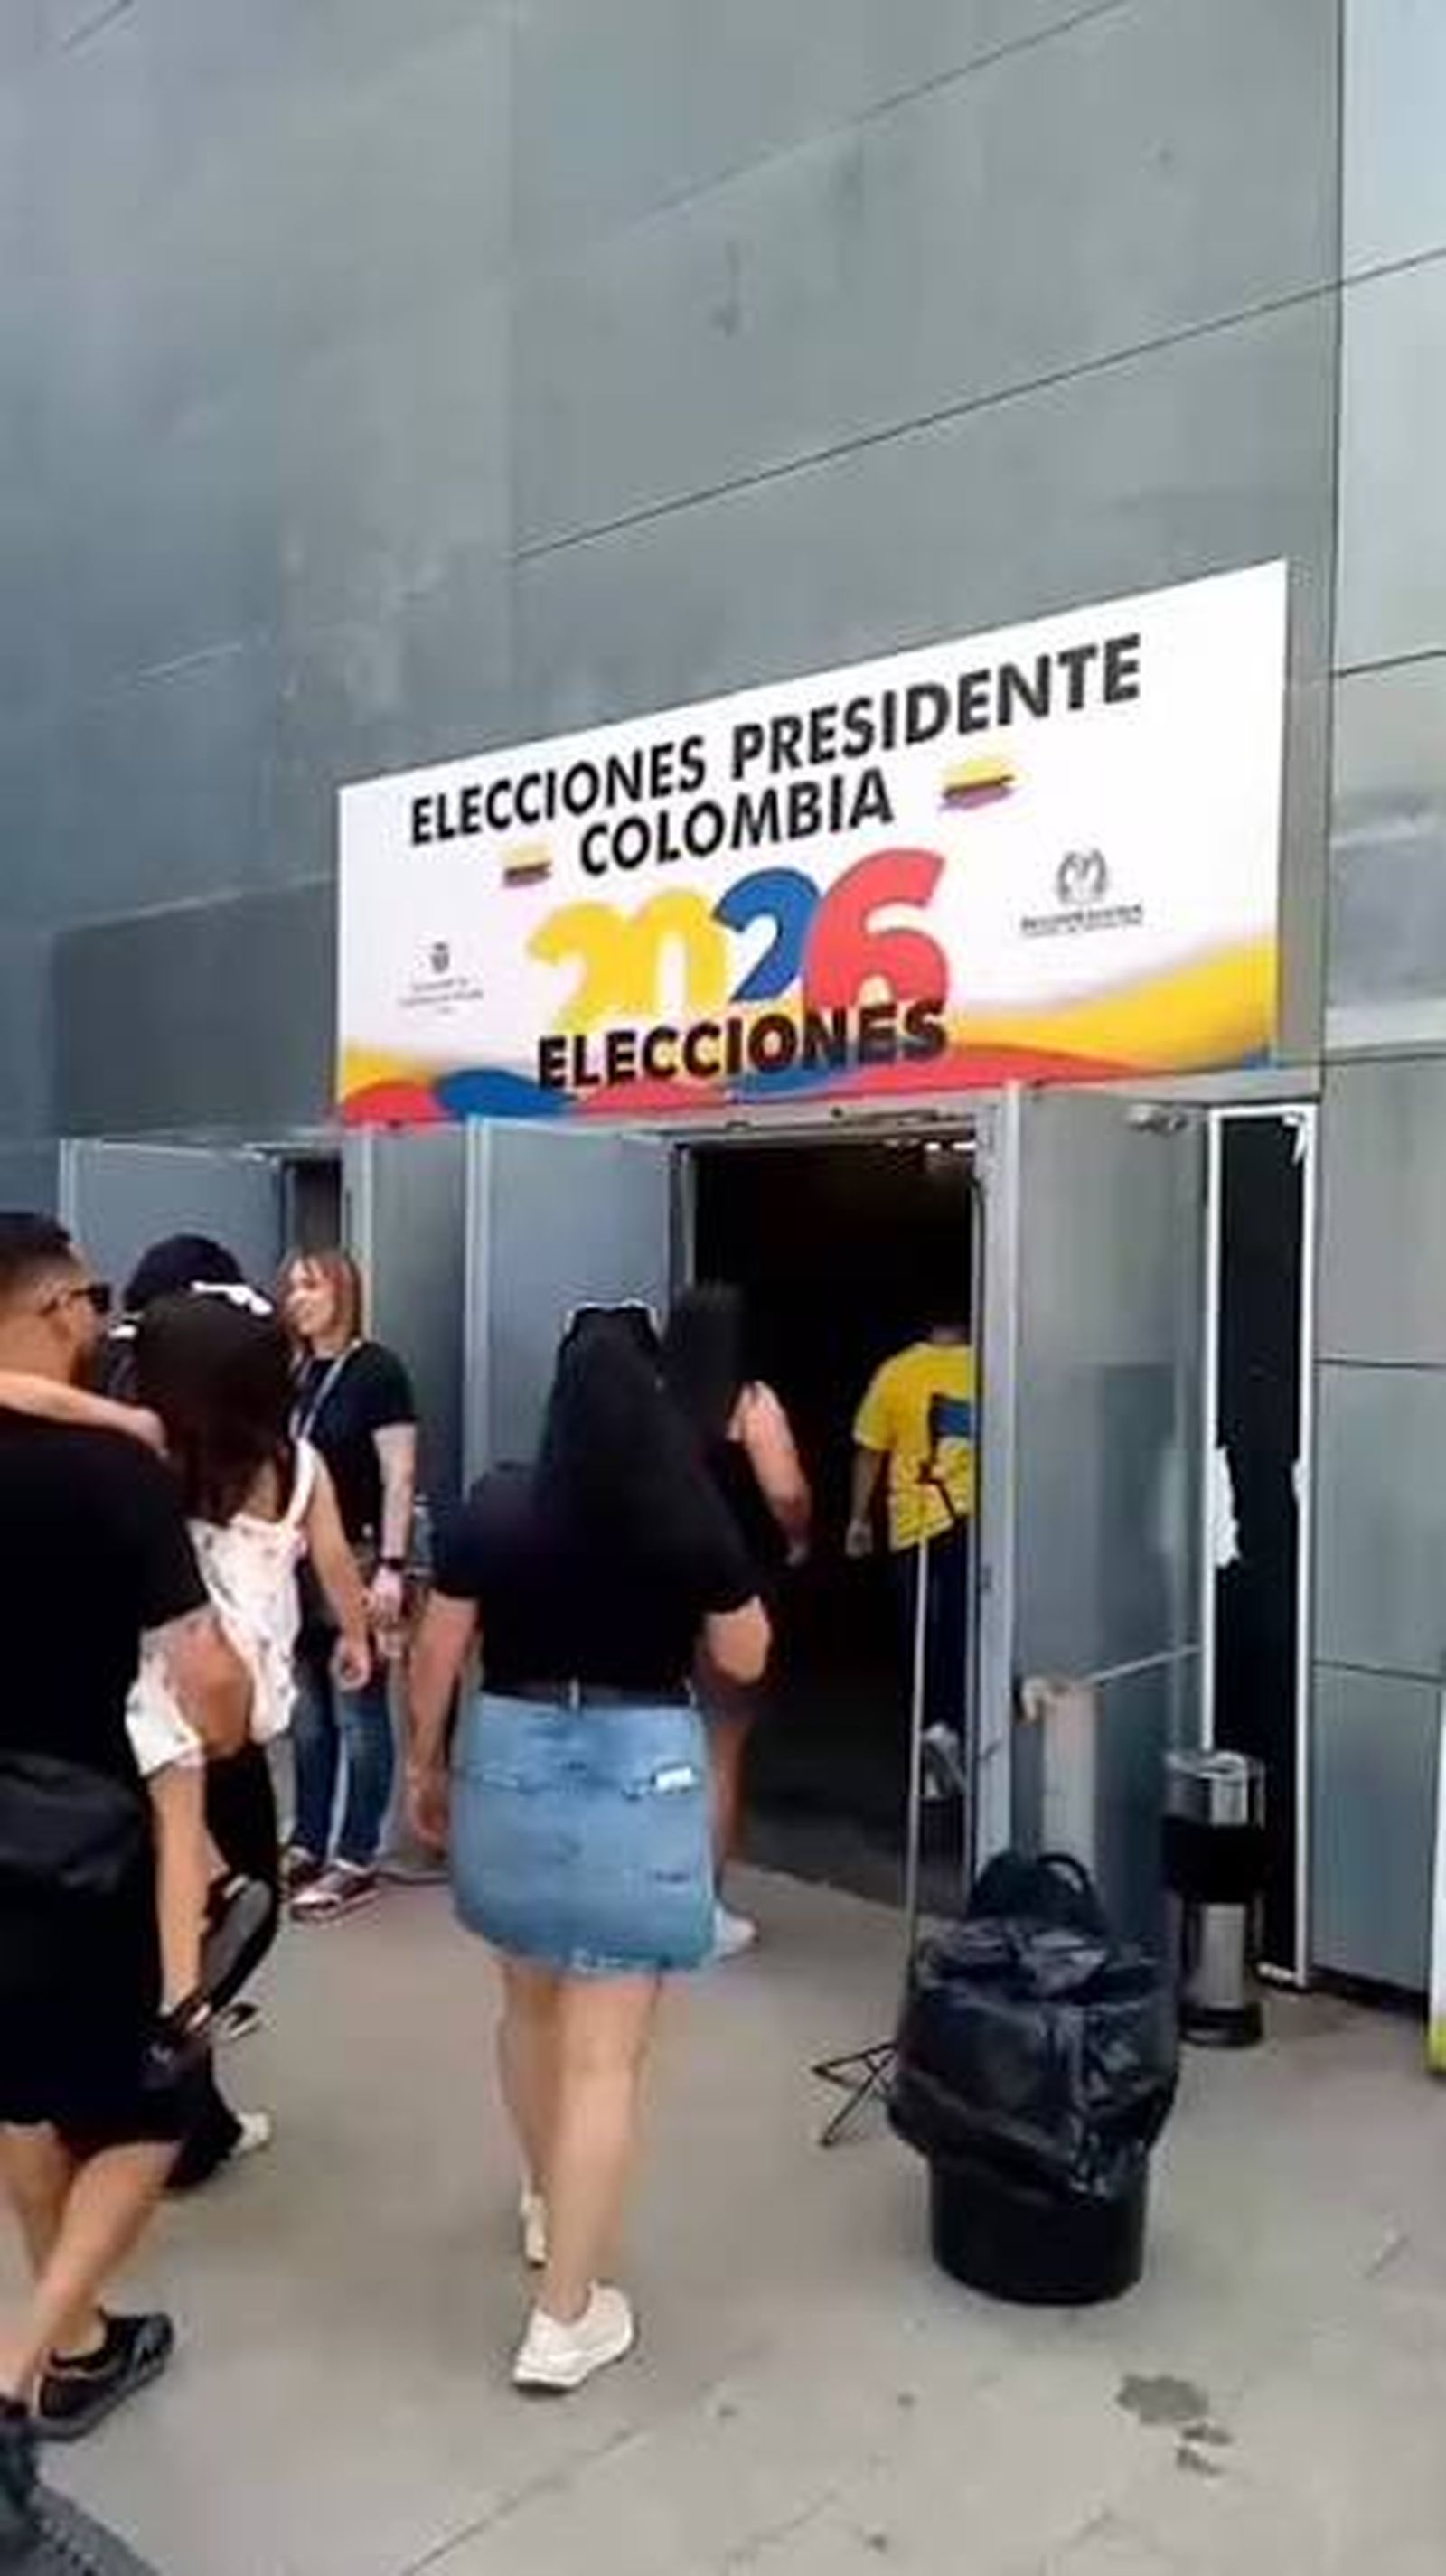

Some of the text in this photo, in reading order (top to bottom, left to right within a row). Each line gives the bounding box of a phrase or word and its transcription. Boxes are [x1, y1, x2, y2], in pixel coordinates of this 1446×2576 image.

[411, 633, 1141, 847] ELECCIONES PRESIDENTE
[579, 766, 895, 876] COLOMBIA
[528, 847, 949, 1036] 2026
[538, 998, 948, 1089] ELECCIONES
